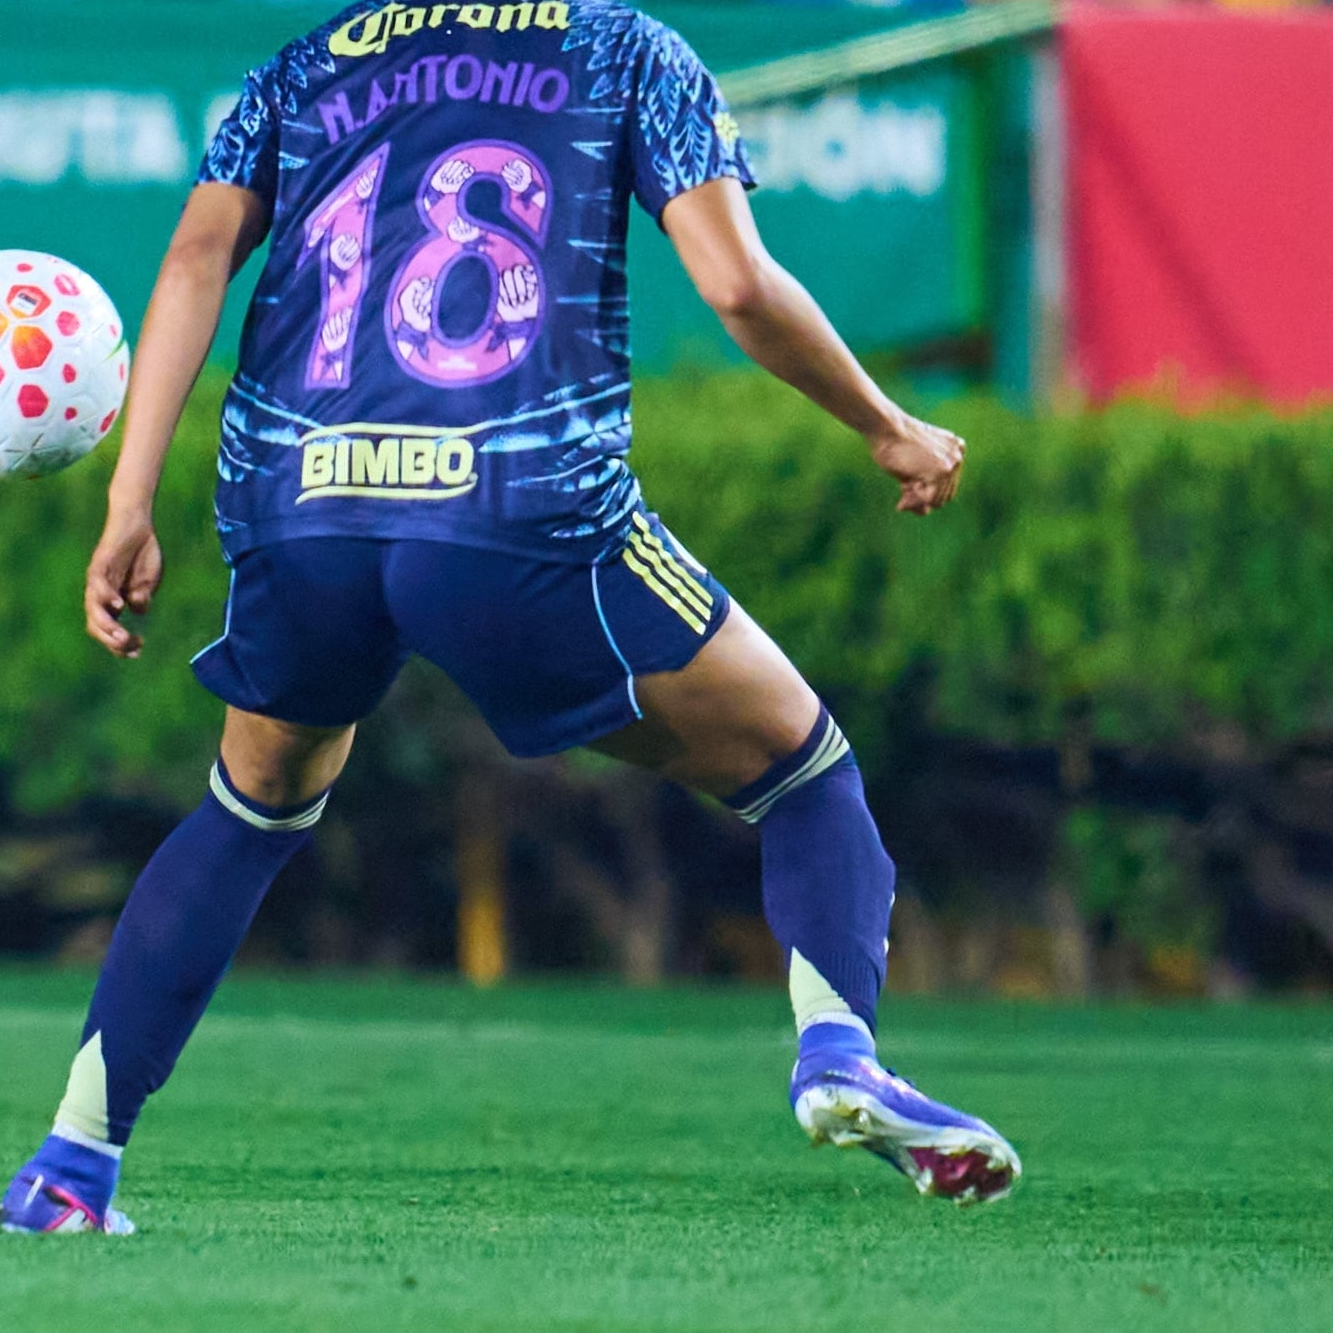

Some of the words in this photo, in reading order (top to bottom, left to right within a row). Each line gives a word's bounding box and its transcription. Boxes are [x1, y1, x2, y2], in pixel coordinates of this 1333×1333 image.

[327, 1, 571, 57] Corona
[296, 139, 553, 389] 18
[301, 437, 475, 489] BIMBO
